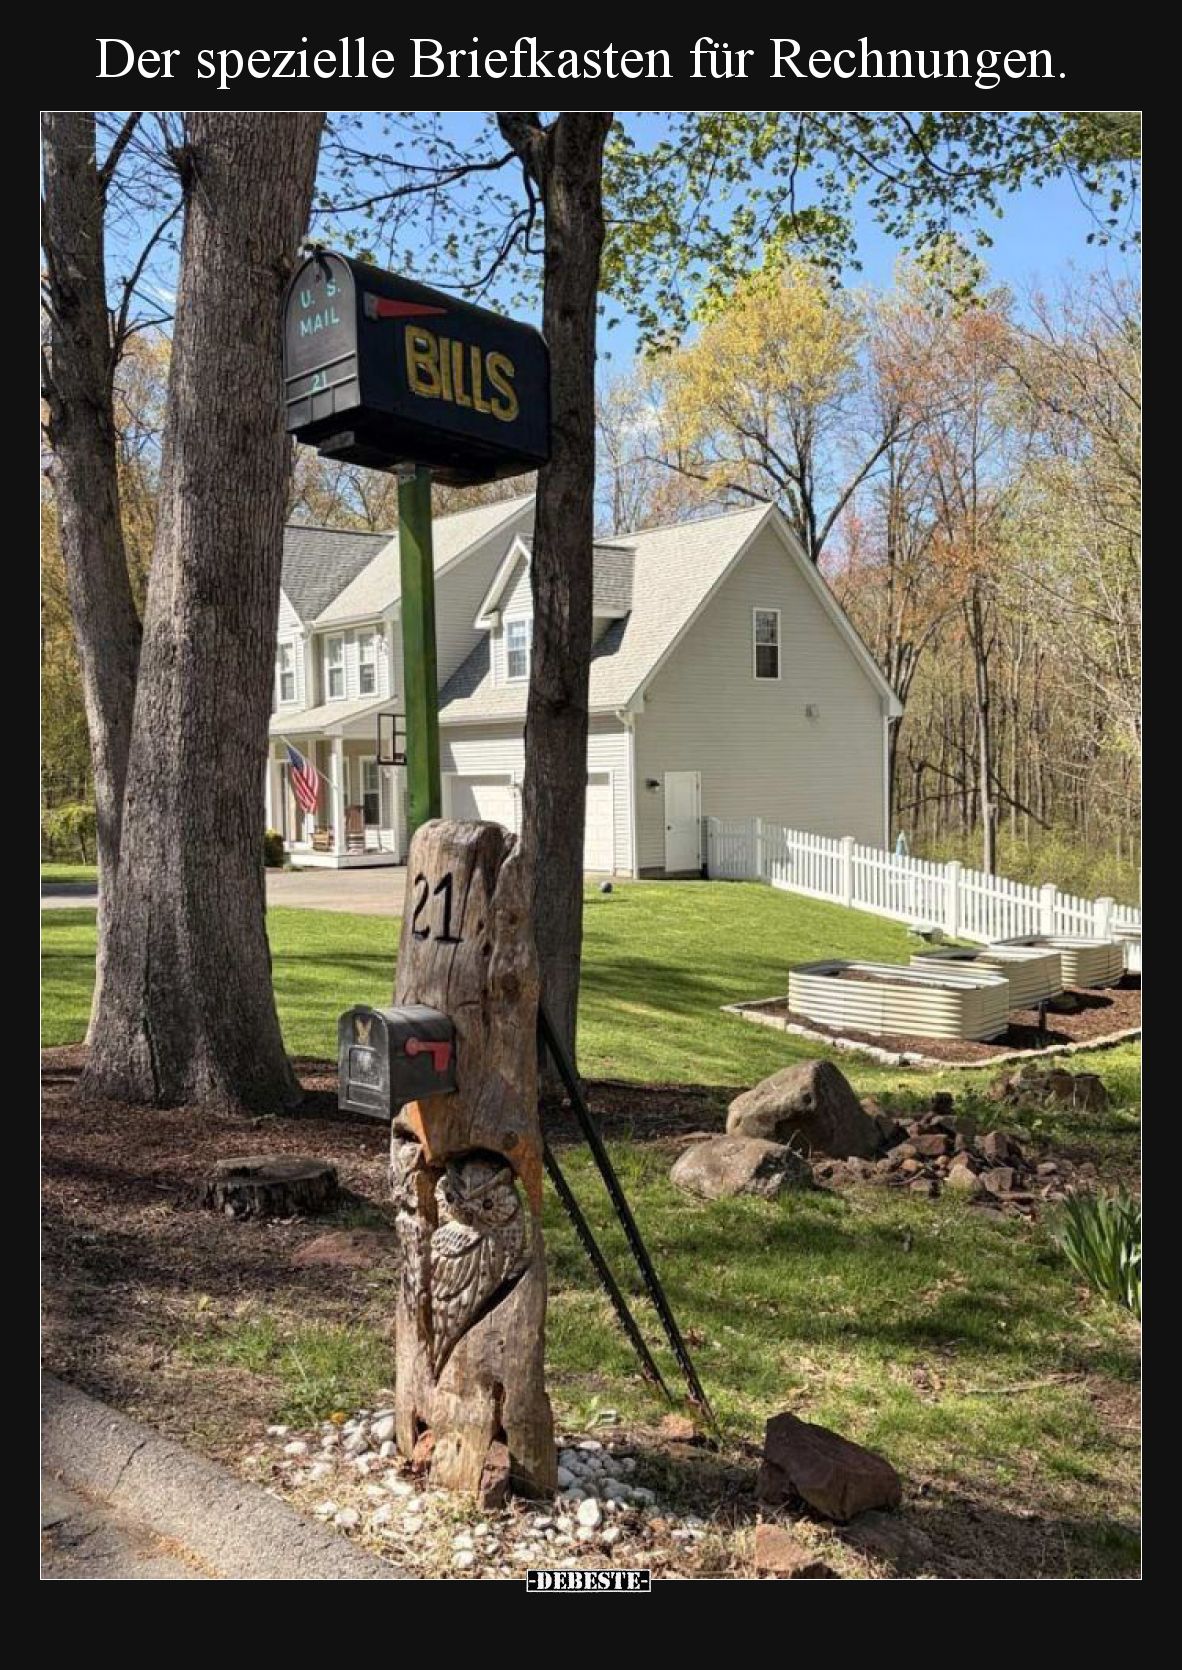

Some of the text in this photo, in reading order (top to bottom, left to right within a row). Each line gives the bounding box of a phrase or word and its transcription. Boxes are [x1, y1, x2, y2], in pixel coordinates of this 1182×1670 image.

[300, 309, 341, 337] MAIL
[310, 370, 328, 395] 21
[405, 324, 519, 423] BILLS
[411, 872, 464, 944] 21
